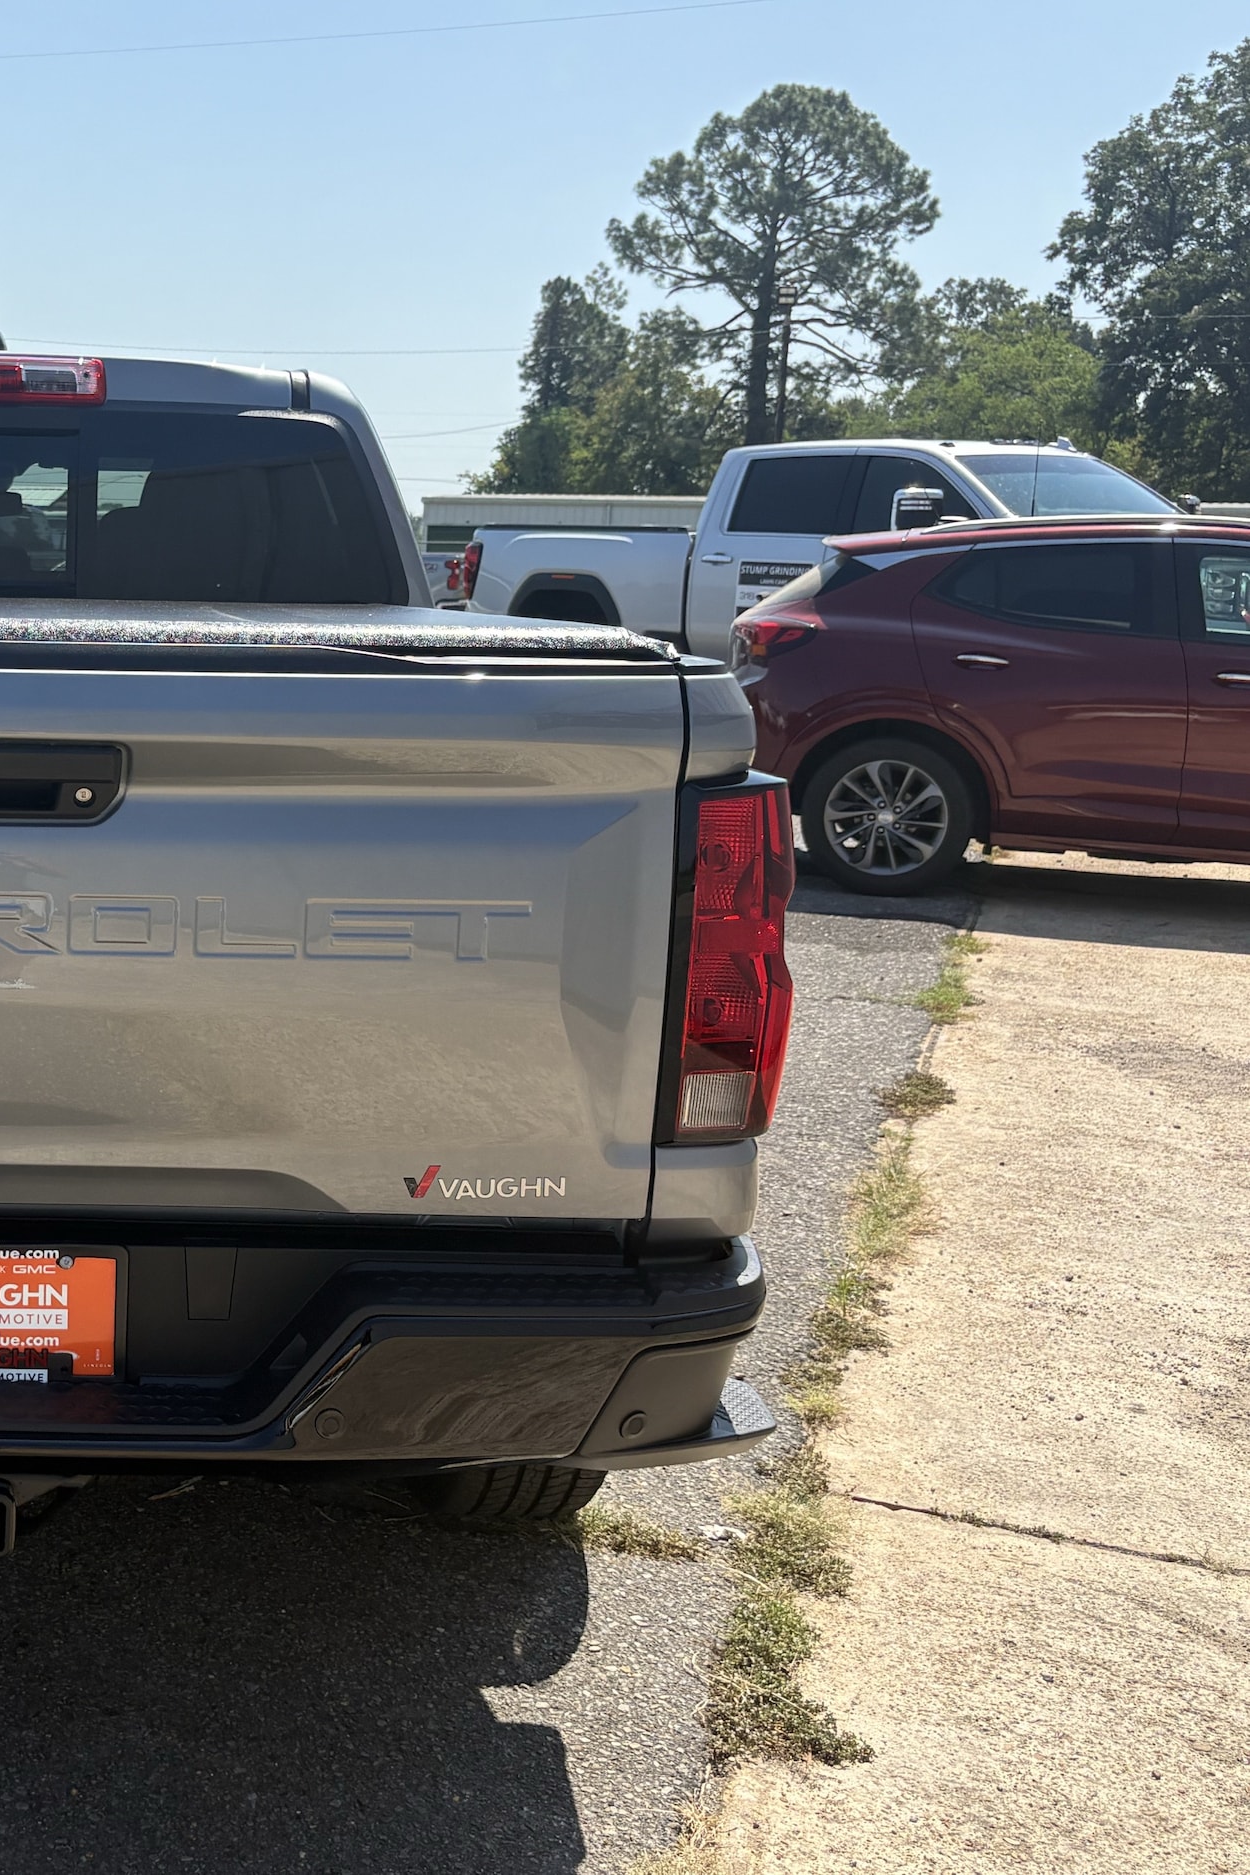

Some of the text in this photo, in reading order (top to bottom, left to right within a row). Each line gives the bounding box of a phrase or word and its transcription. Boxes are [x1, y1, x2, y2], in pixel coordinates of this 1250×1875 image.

[741, 565, 768, 575] STUMP
[438, 1176, 566, 1200] VAUGHN
[12, 1264, 56, 1274] GMC
